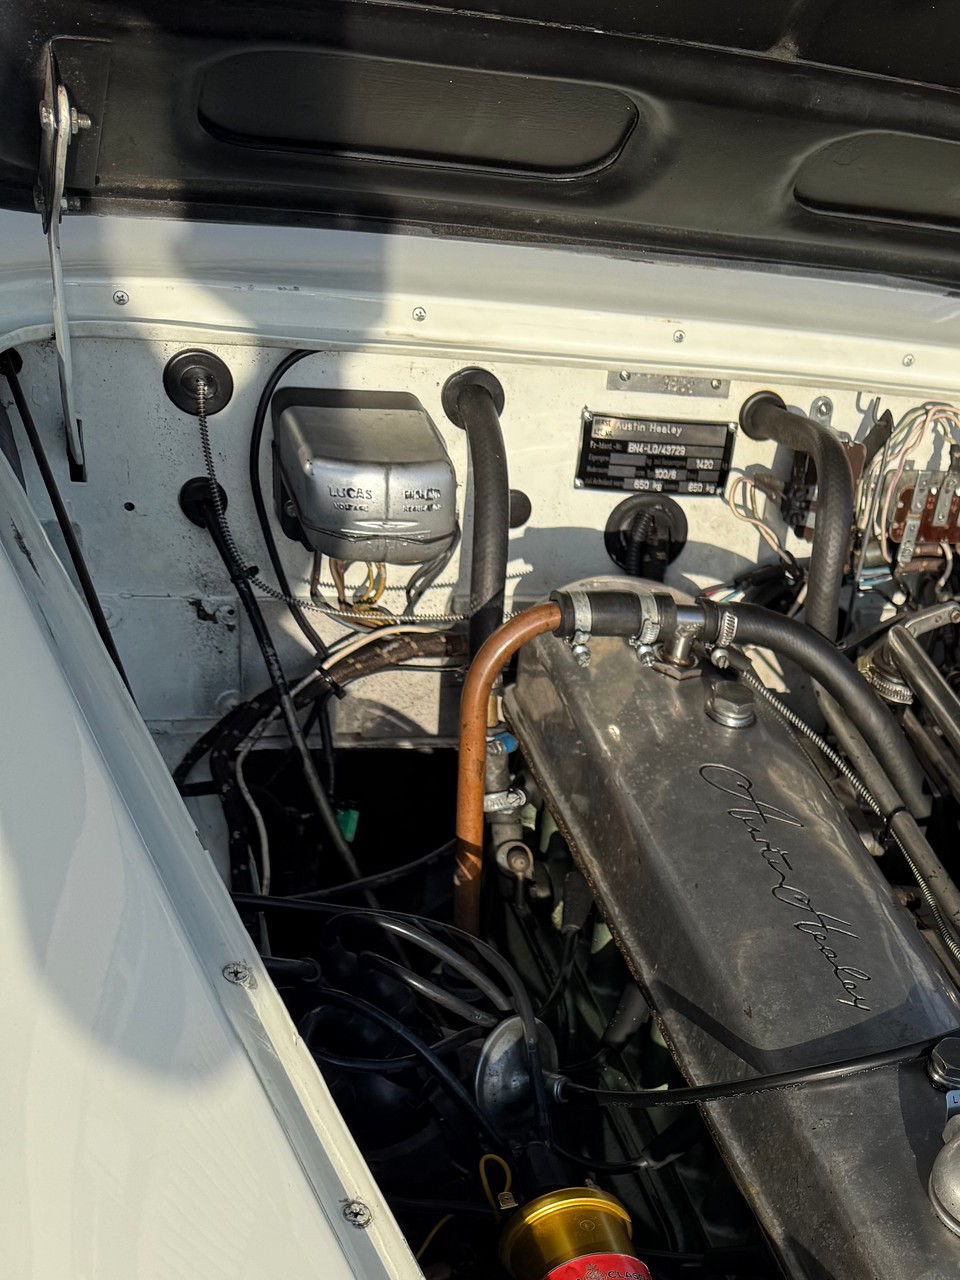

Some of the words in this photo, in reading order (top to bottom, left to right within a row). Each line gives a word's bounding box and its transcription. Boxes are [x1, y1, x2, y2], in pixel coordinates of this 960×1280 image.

[616, 420, 646, 432] Austin
[650, 424, 683, 436] Healey
[696, 459, 714, 470] 1420
[655, 469, 677, 480] 100/6
[634, 480, 649, 490] 650
[688, 482, 703, 493] 650
[328, 485, 373, 499] LUCAS
